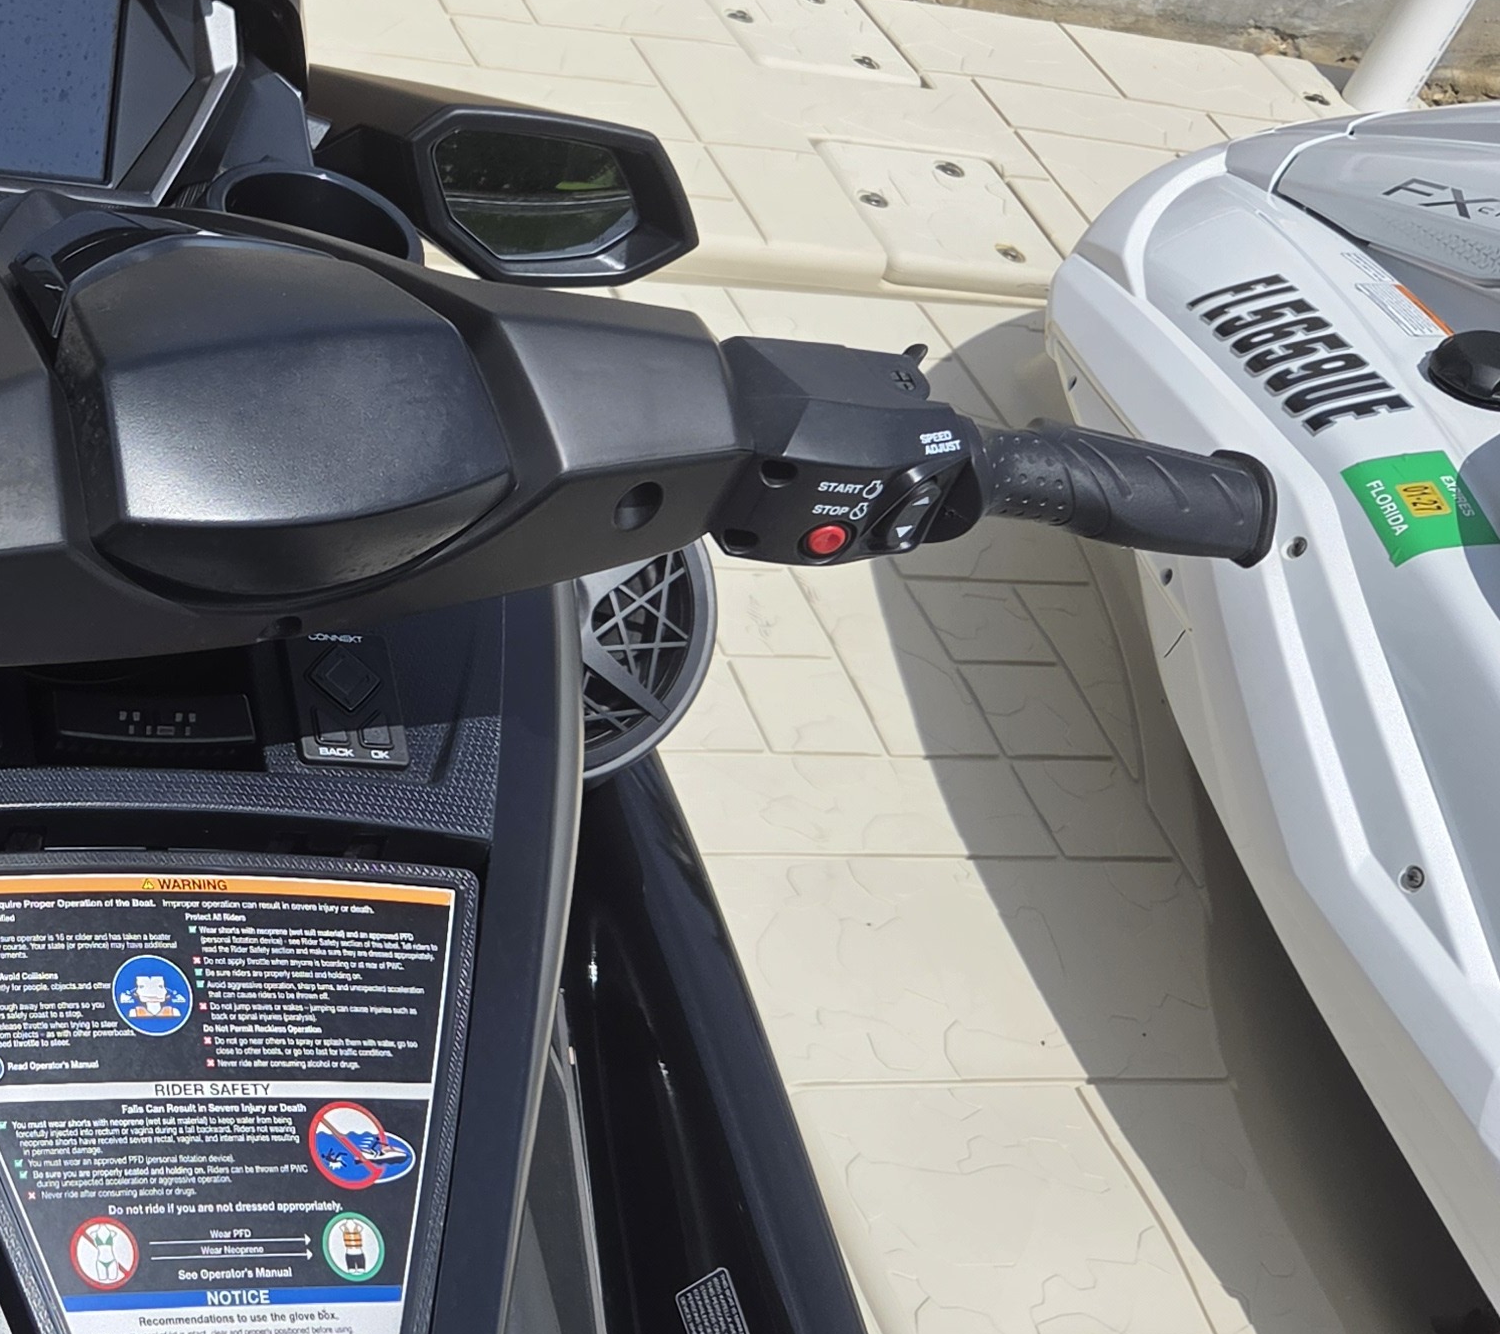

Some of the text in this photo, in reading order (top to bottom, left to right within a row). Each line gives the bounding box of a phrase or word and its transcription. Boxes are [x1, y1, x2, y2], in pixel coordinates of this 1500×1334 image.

[1382, 177, 1500, 219] FX
[919, 430, 952, 444] SPEED
[925, 440, 961, 455] ADJUST
[817, 481, 864, 495] START
[1440, 475, 1475, 517] EXPIRES
[812, 504, 849, 516] STOP
[1366, 479, 1409, 536] FLORIDA
[318, 747, 354, 758] BACK
[370, 749, 390, 760] OK
[157, 879, 228, 891] WARNING
[155, 1083, 270, 1097] RIDER SAFETY
[121, 1103, 306, 1115] Falls Can Result in Severe Injury or Death
[108, 1201, 343, 1216] Do not ride if you are not dressed appropriately.
[209, 1229, 251, 1238] Wear PFD
[200, 1245, 263, 1256] Wear Neoprene
[177, 1267, 292, 1281] See Operator's Manual
[206, 1289, 271, 1305] NOTICE
[138, 1311, 339, 1327] Recommendations to use the glove box.
